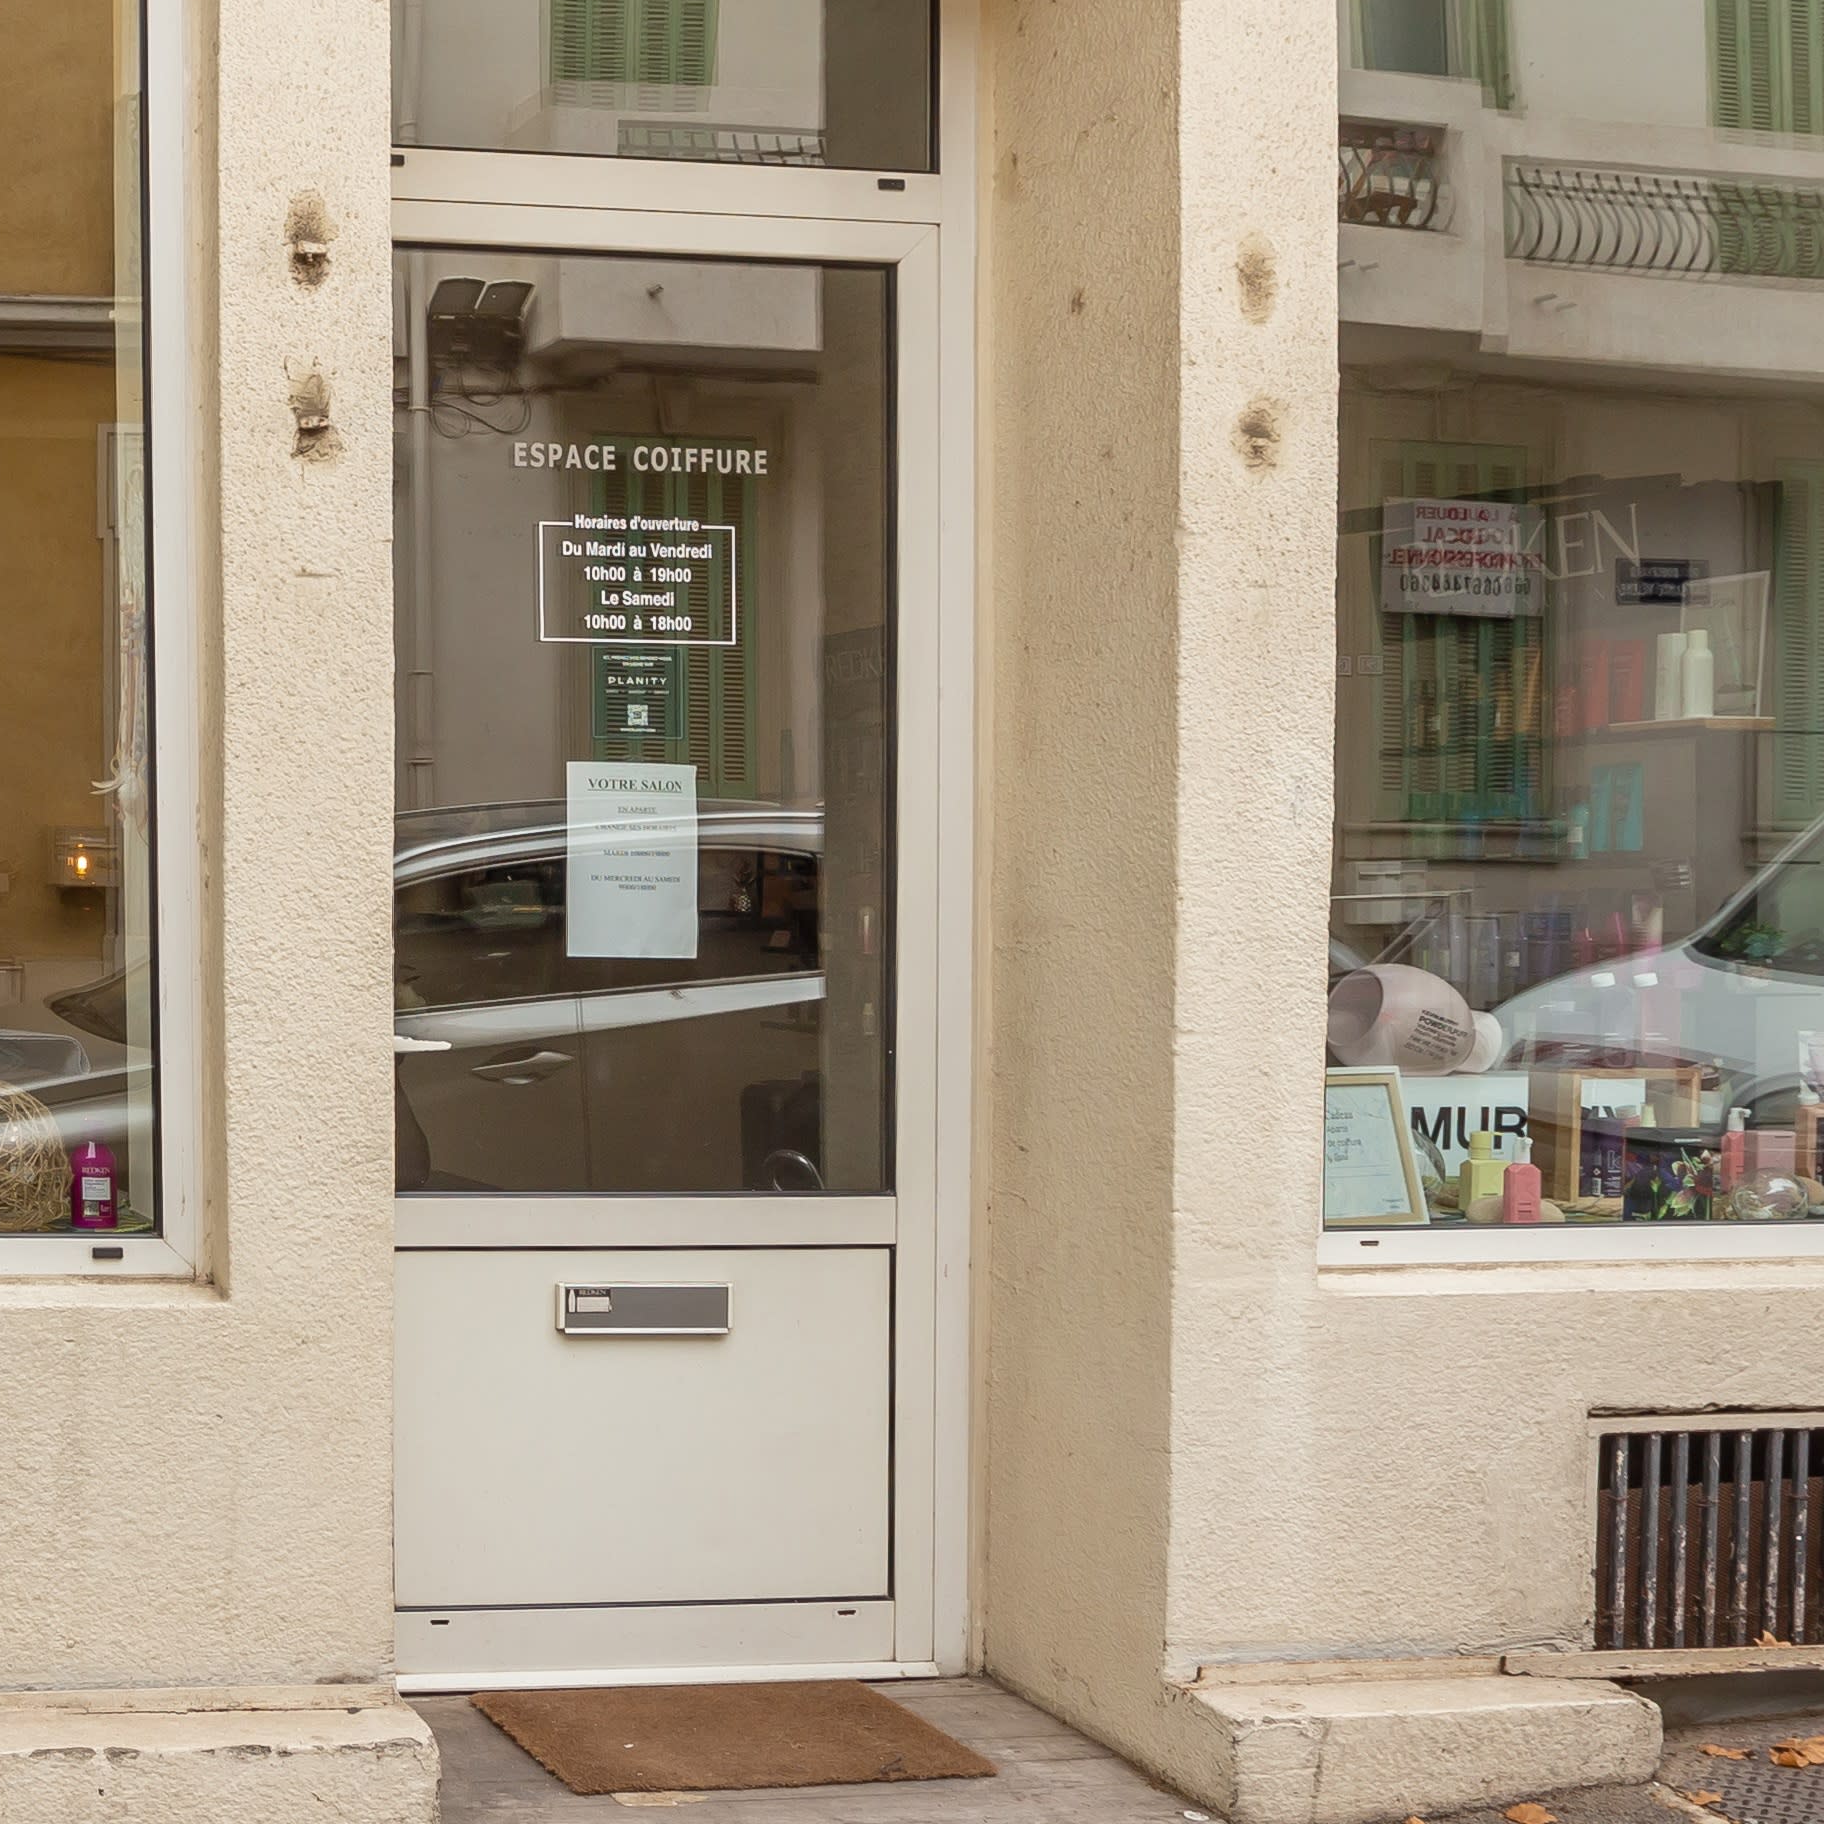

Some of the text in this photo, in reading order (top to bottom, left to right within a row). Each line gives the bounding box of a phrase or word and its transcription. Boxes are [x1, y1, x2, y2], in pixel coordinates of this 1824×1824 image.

[514, 442, 768, 474] ESPACE COIFFURE
[575, 514, 699, 531] Horaires d'ouverture
[562, 541, 712, 559] Du Mardi au Vendredi
[584, 566, 692, 582] 10h00 à 19h00
[601, 590, 674, 606] Le Samedi
[584, 615, 692, 631] 10h00 à 18h00
[608, 677, 666, 685] PLANITY
[588, 778, 682, 791] VOTRE SALON
